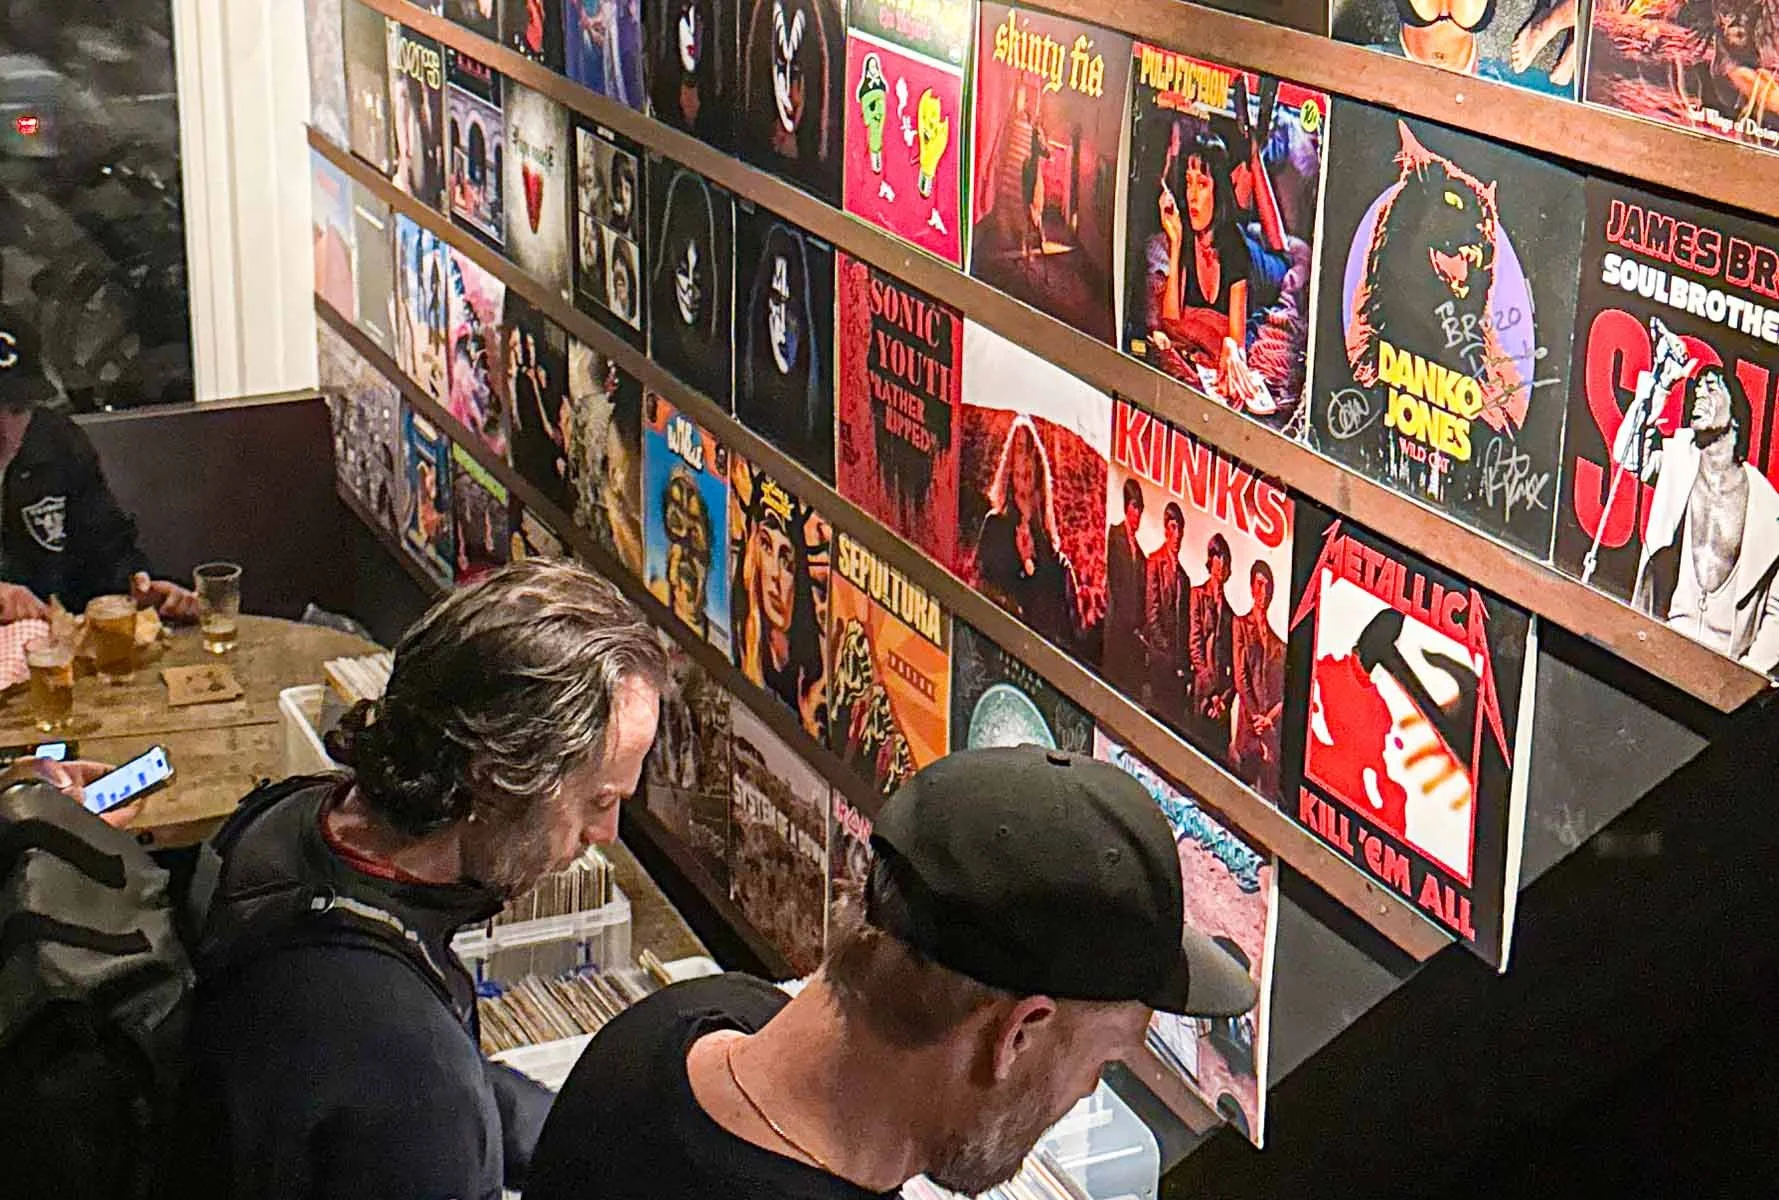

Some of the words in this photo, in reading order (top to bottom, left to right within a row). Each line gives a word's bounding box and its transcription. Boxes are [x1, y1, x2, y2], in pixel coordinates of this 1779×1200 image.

[991, 8, 1065, 94] skinty
[1069, 34, 1104, 97] fia
[1140, 47, 1175, 92] PULP
[1174, 55, 1230, 110] FICTION
[1607, 199, 1721, 277] JAMES
[1725, 237, 1779, 300] BR
[870, 277, 940, 348] SONIC
[1602, 252, 1779, 345] SOULBROTHE
[1377, 339, 1483, 421] DANKO
[1384, 387, 1472, 461] JONES
[1114, 399, 1289, 549] KINKS
[1398, 436, 1426, 464] WILD
[838, 533, 942, 646] SEPULTURA
[1290, 519, 1503, 700] METALLICA
[1299, 785, 1354, 857] KILL
[1358, 826, 1412, 897] 'EM
[1418, 871, 1476, 943] ALL
